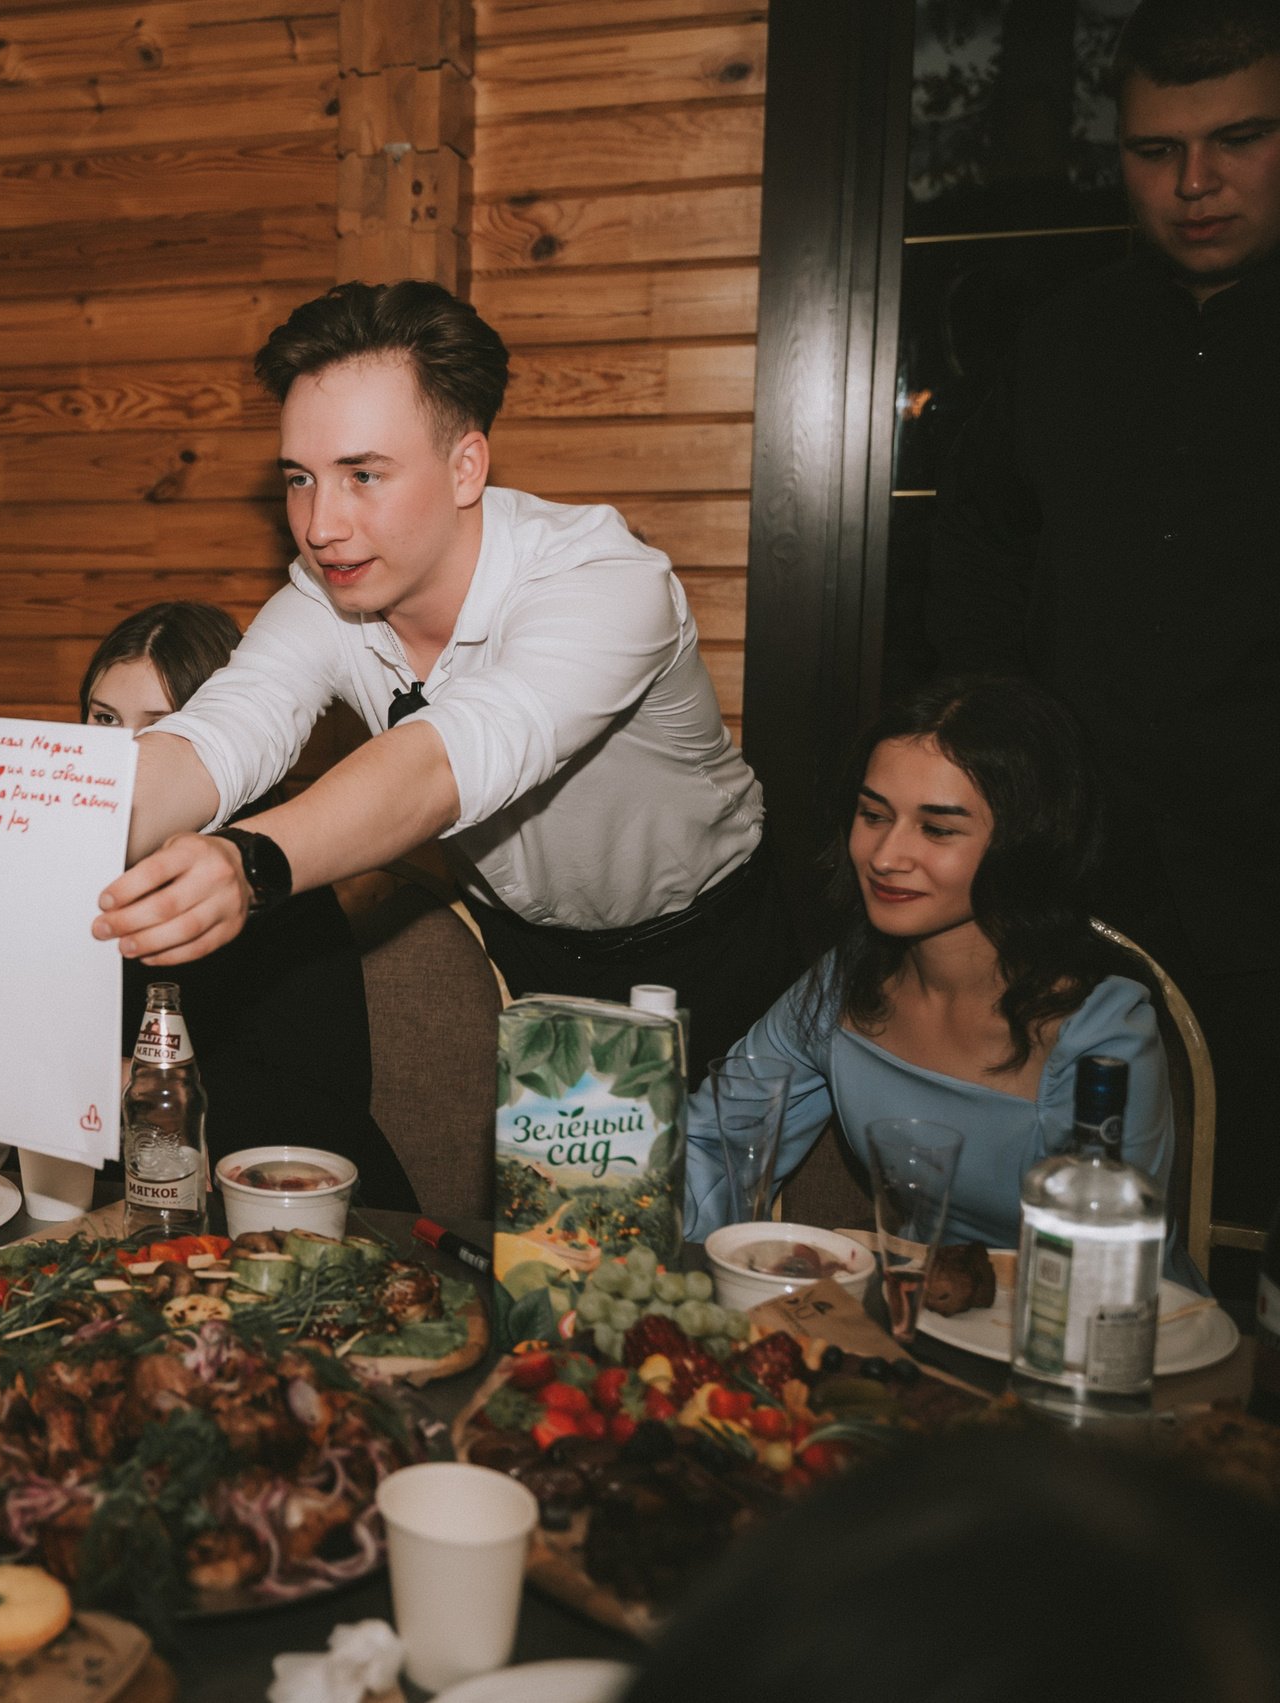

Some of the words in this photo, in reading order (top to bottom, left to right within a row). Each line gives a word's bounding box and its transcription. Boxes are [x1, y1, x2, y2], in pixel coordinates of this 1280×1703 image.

[513, 1106, 644, 1142] Зелёный
[547, 1140, 637, 1178] сад
[129, 1181, 178, 1198] МЯГКОЕ
